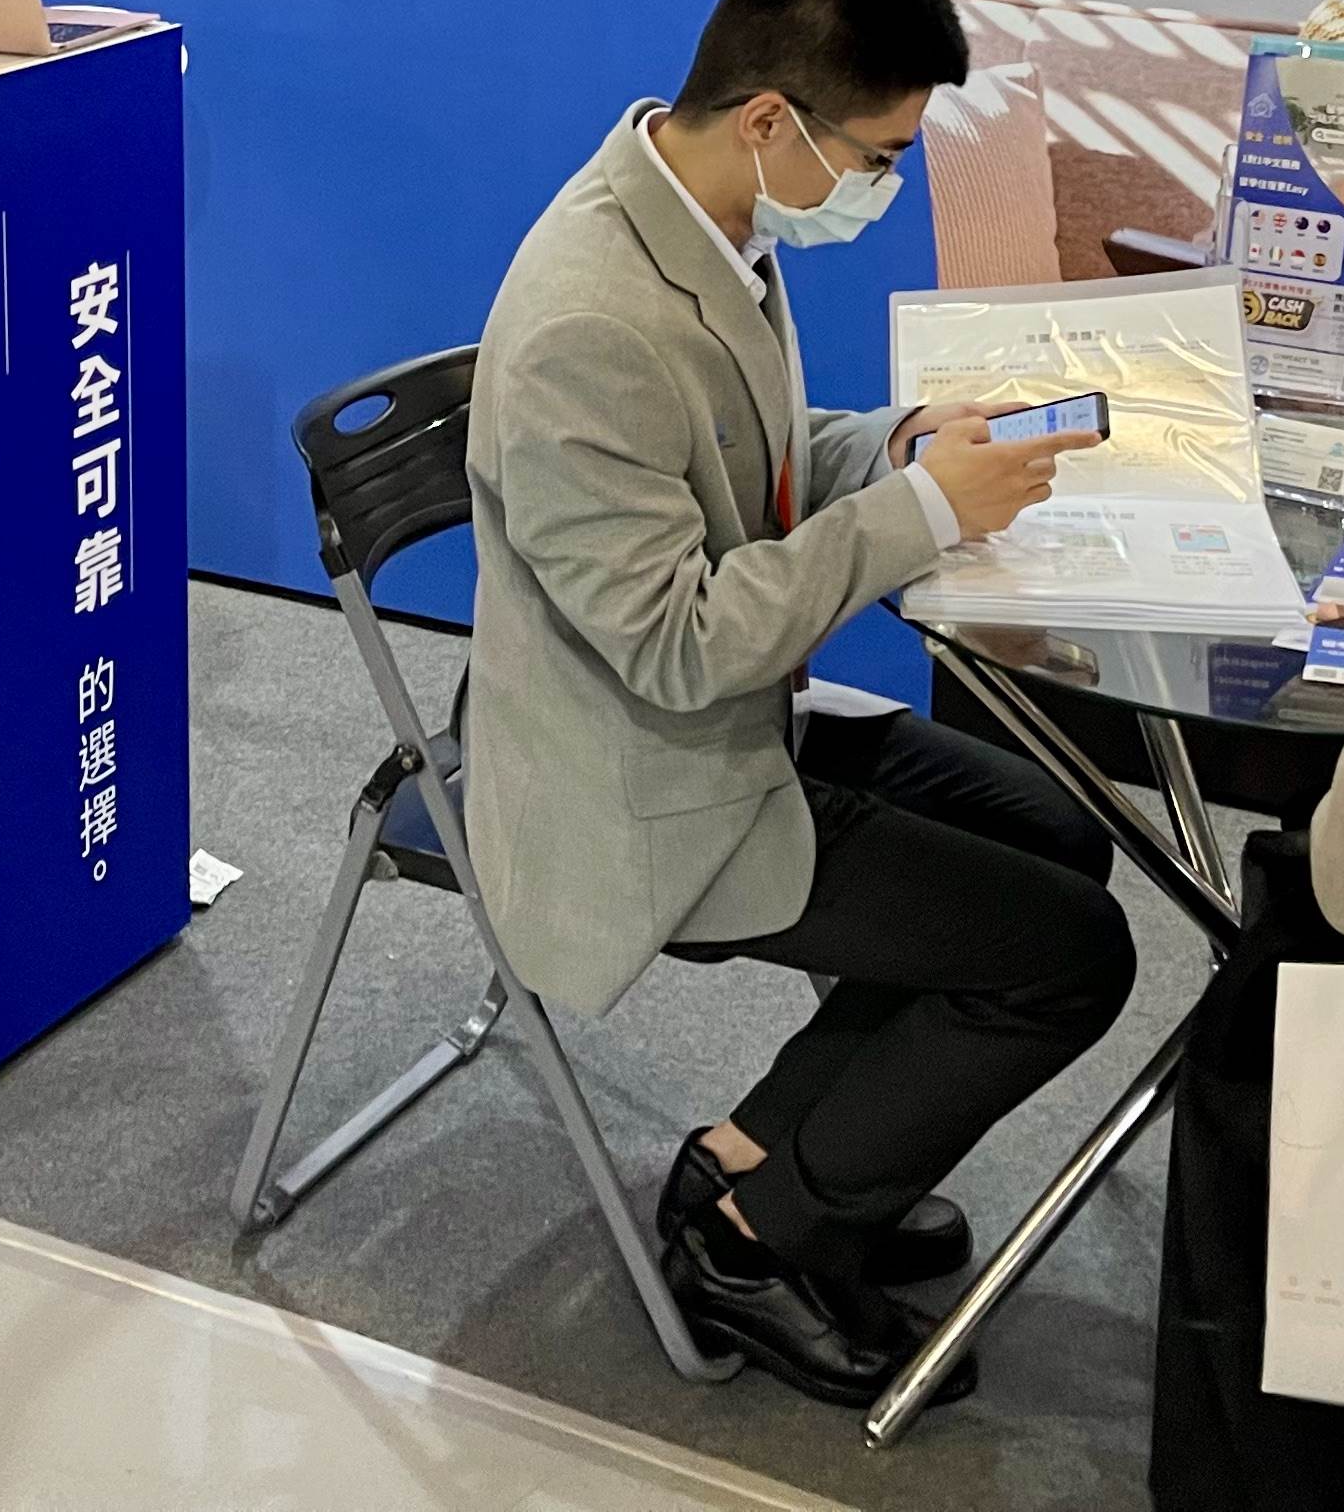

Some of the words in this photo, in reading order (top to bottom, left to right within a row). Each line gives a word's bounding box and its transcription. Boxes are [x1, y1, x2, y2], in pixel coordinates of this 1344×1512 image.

[1267, 296, 1305, 314] CASH
[1263, 311, 1302, 327] BACK
[70, 261, 123, 615] 安全可靠
